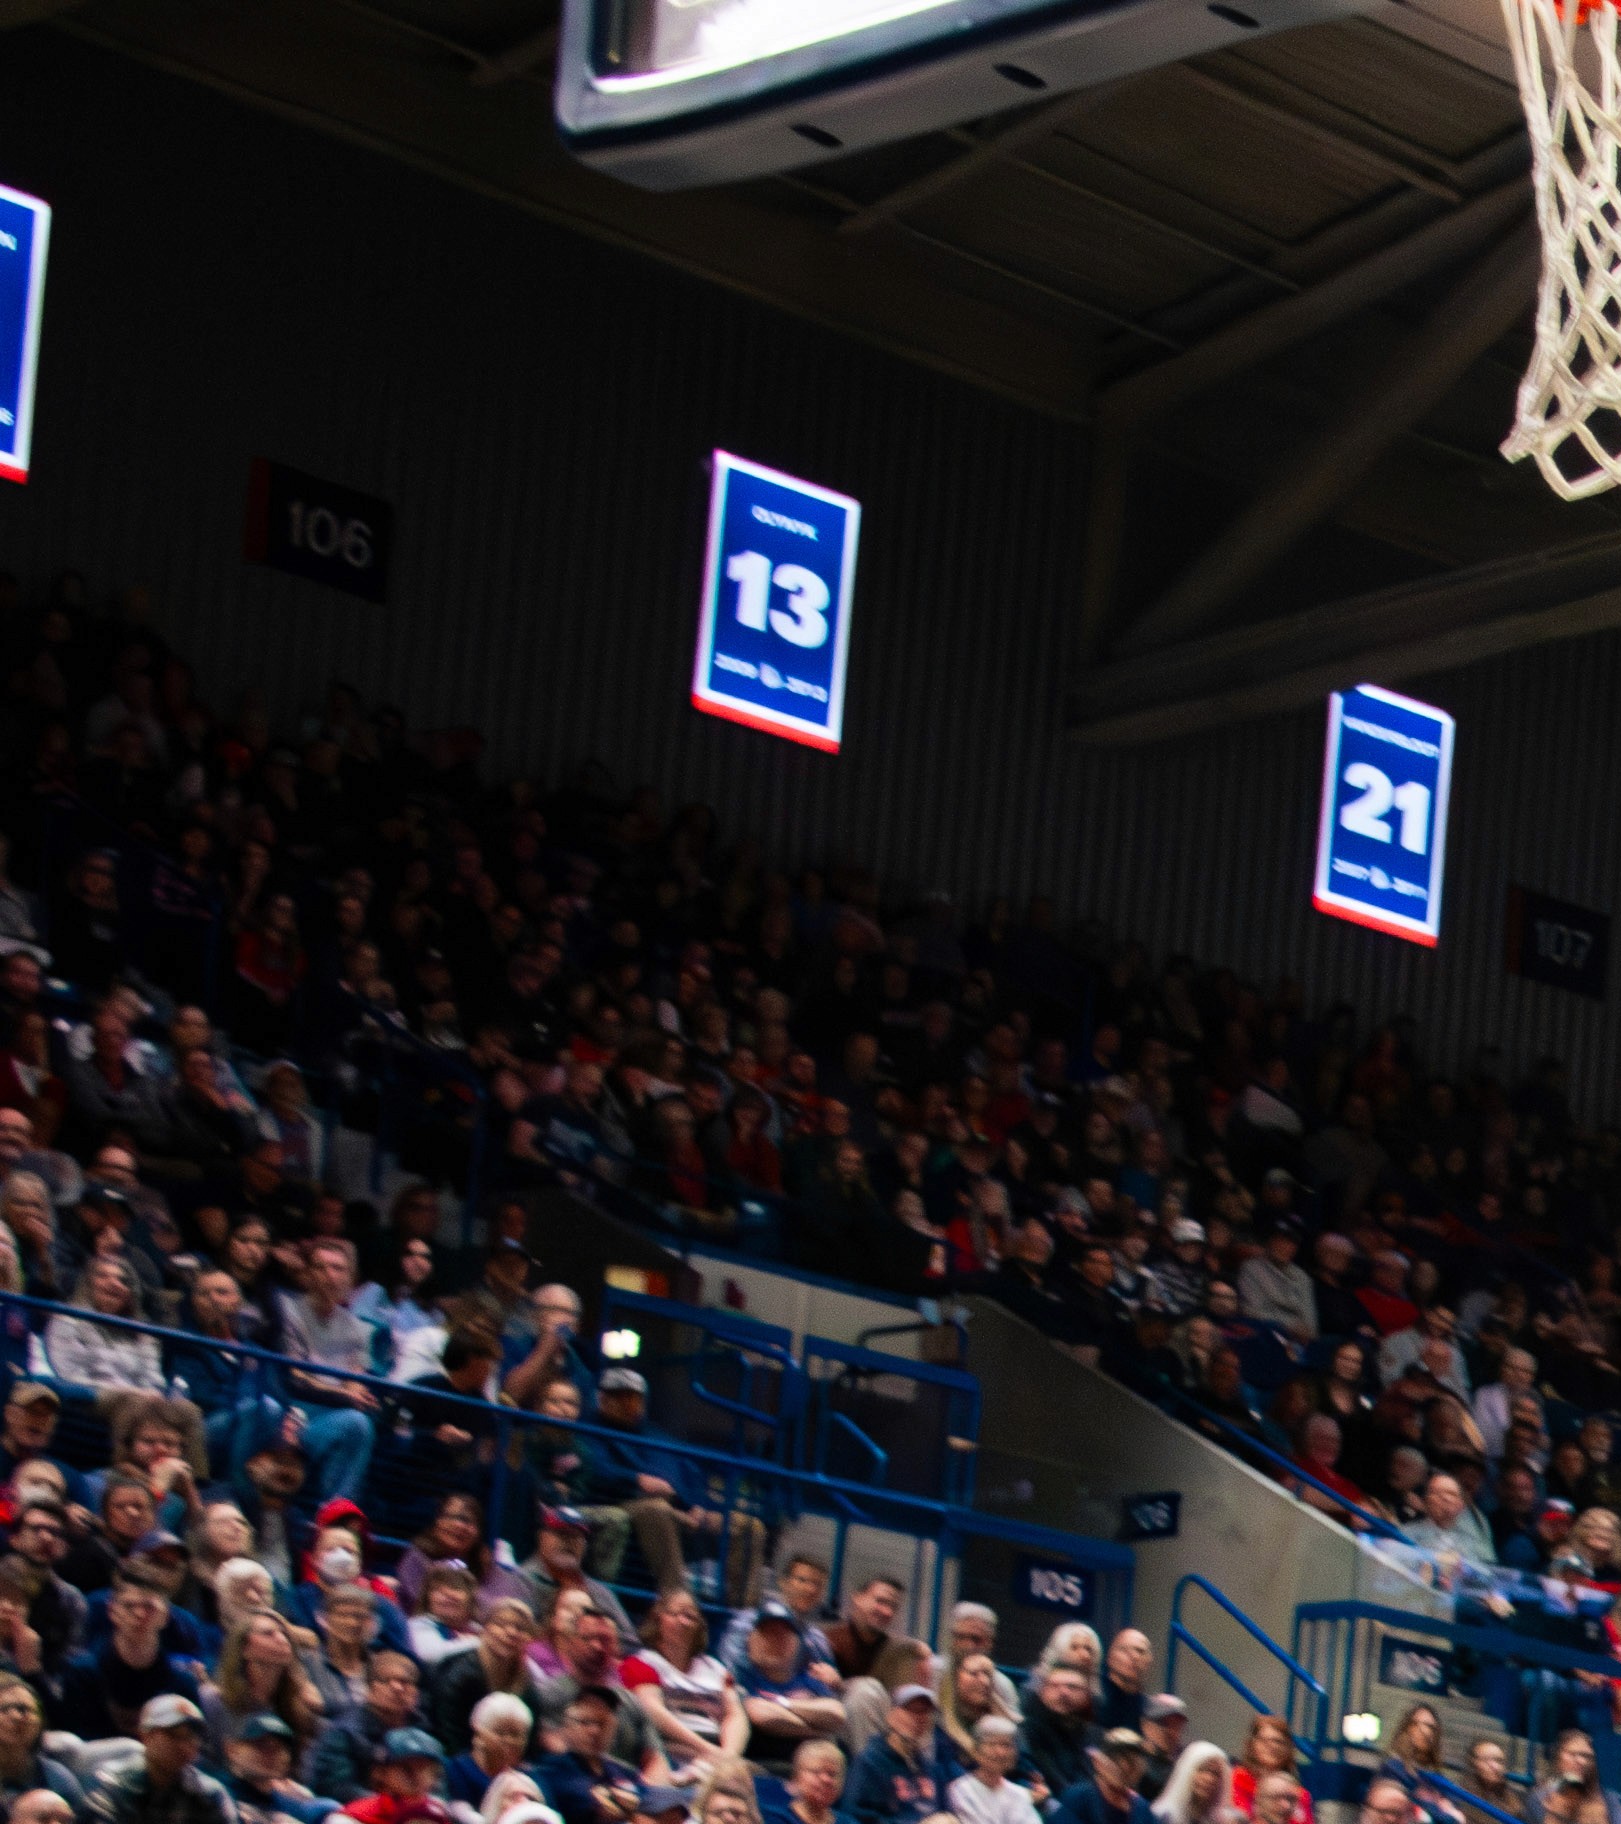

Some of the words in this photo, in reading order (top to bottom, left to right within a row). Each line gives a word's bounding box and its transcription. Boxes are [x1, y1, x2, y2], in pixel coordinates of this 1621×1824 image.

[288, 498, 374, 569] 106
[727, 550, 830, 648] 13
[1340, 762, 1430, 855] 21
[1534, 919, 1593, 970] 107
[1029, 1566, 1084, 1608] 105
